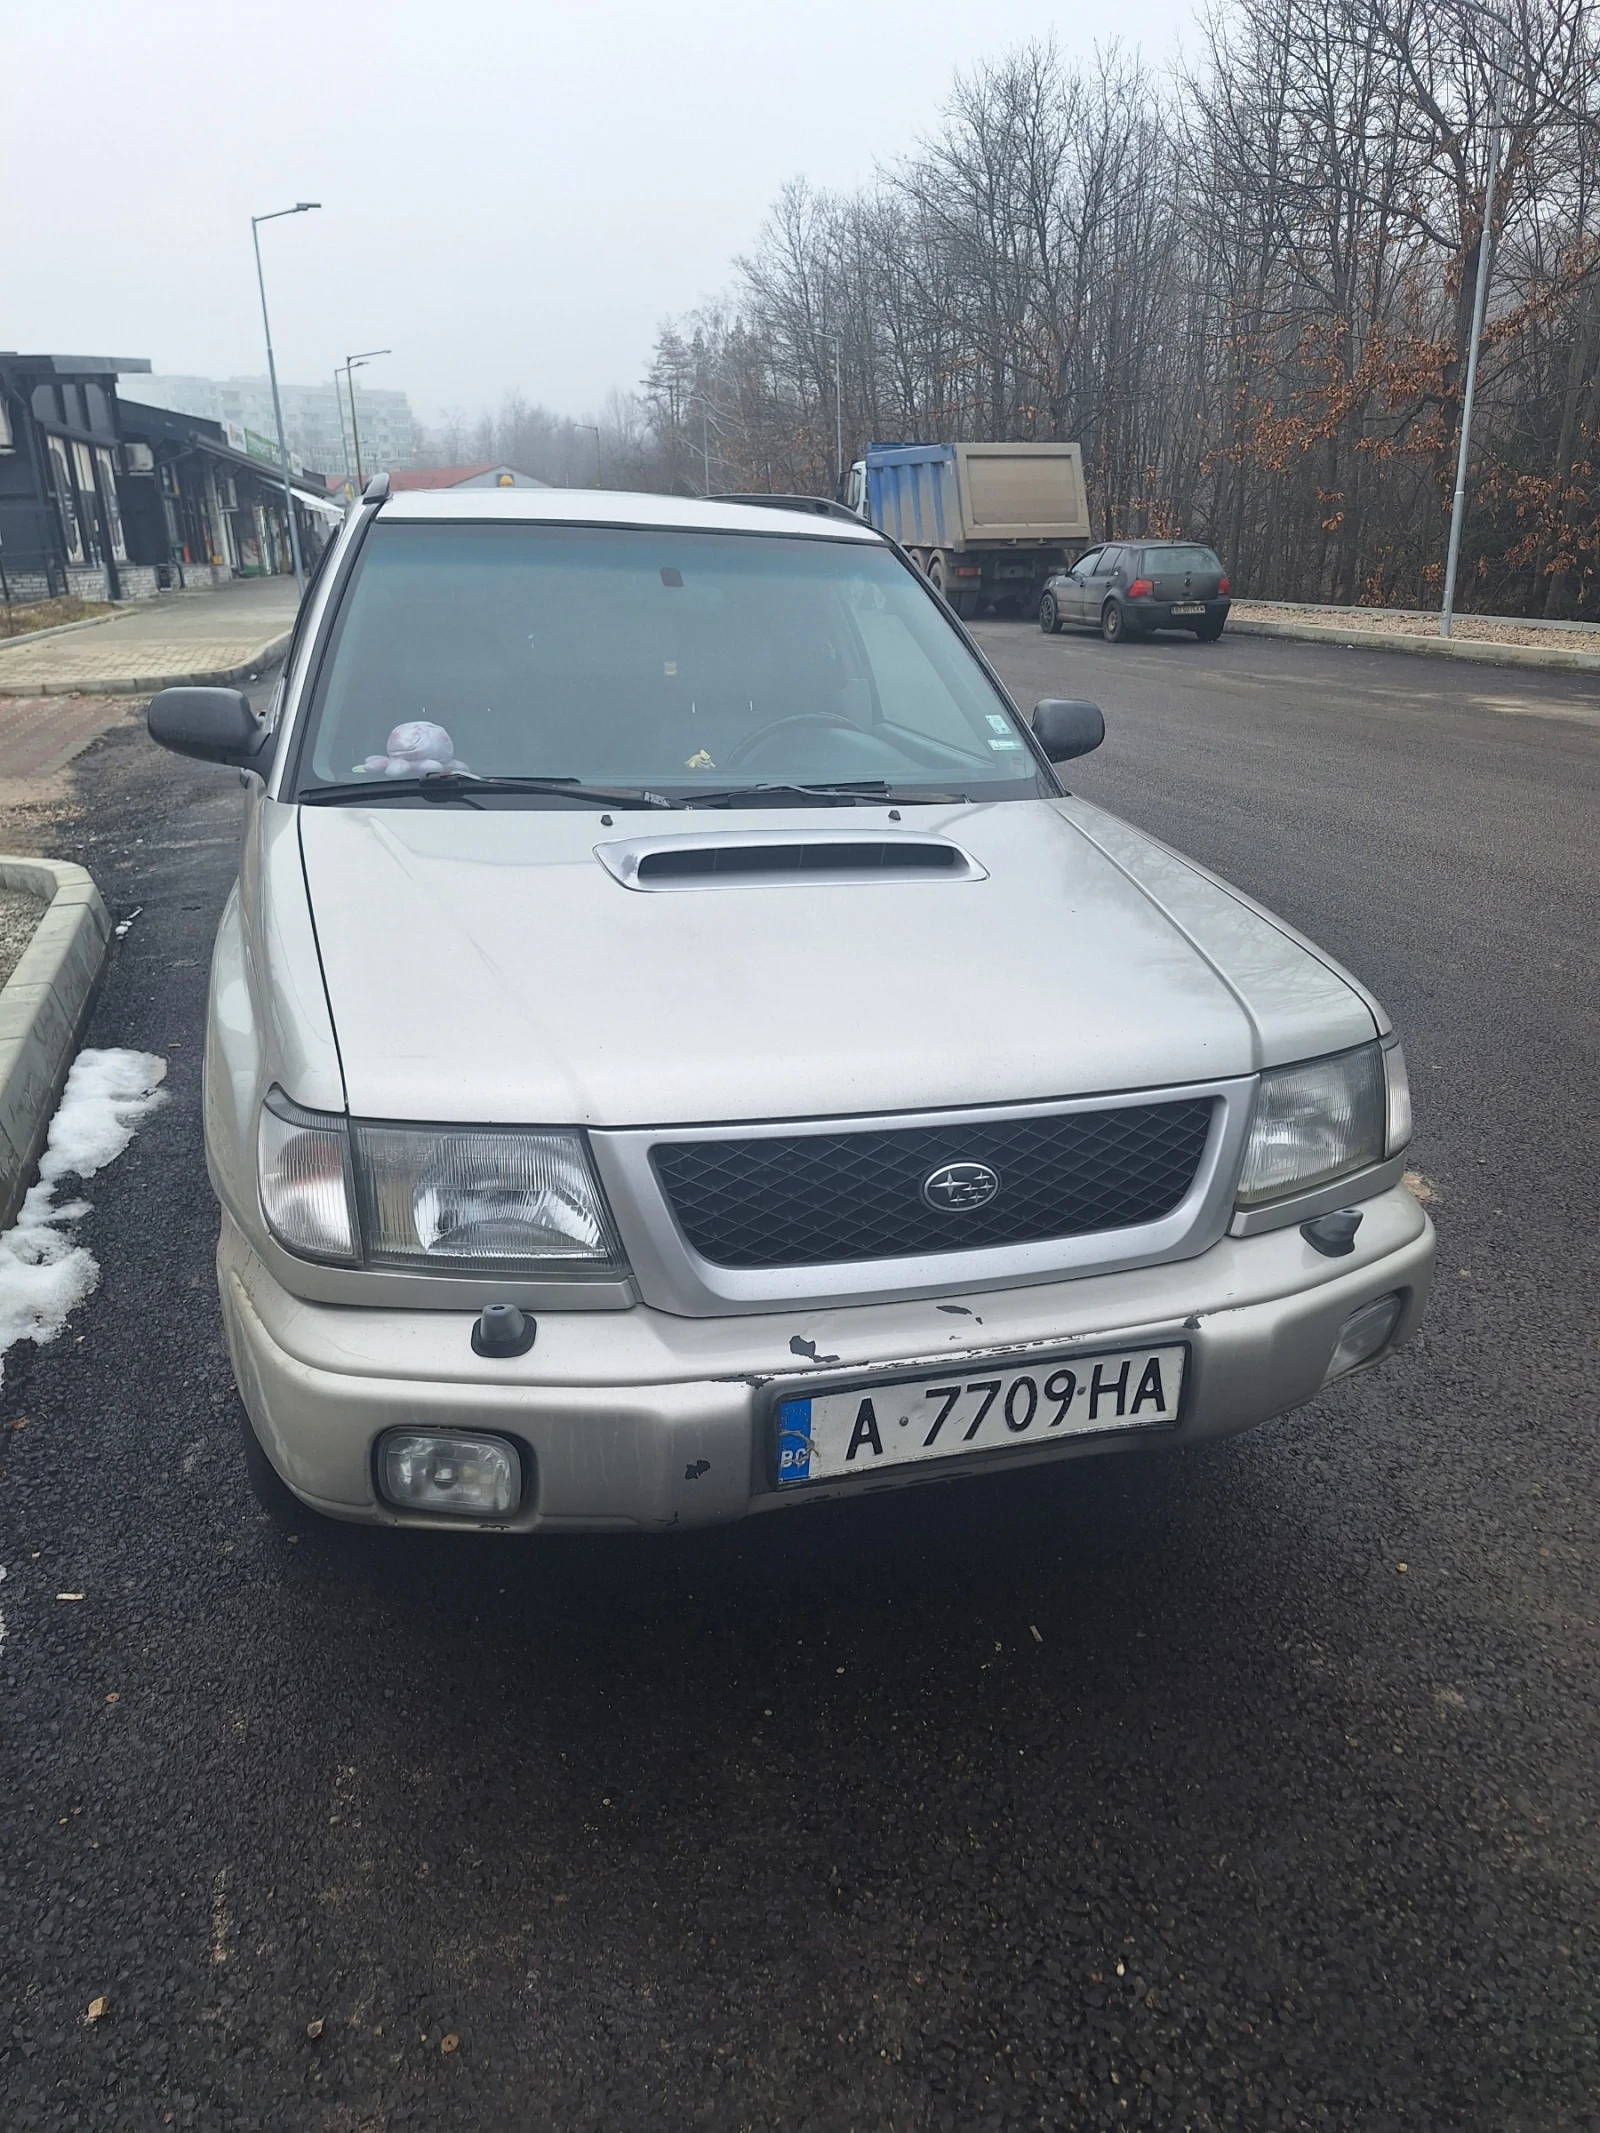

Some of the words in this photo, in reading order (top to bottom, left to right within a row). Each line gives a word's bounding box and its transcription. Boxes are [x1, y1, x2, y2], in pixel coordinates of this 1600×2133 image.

[845, 1397, 884, 1461] A
[921, 1368, 1077, 1447] 7709
[1087, 1356, 1167, 1420] HA
[781, 1447, 808, 1468] BG
